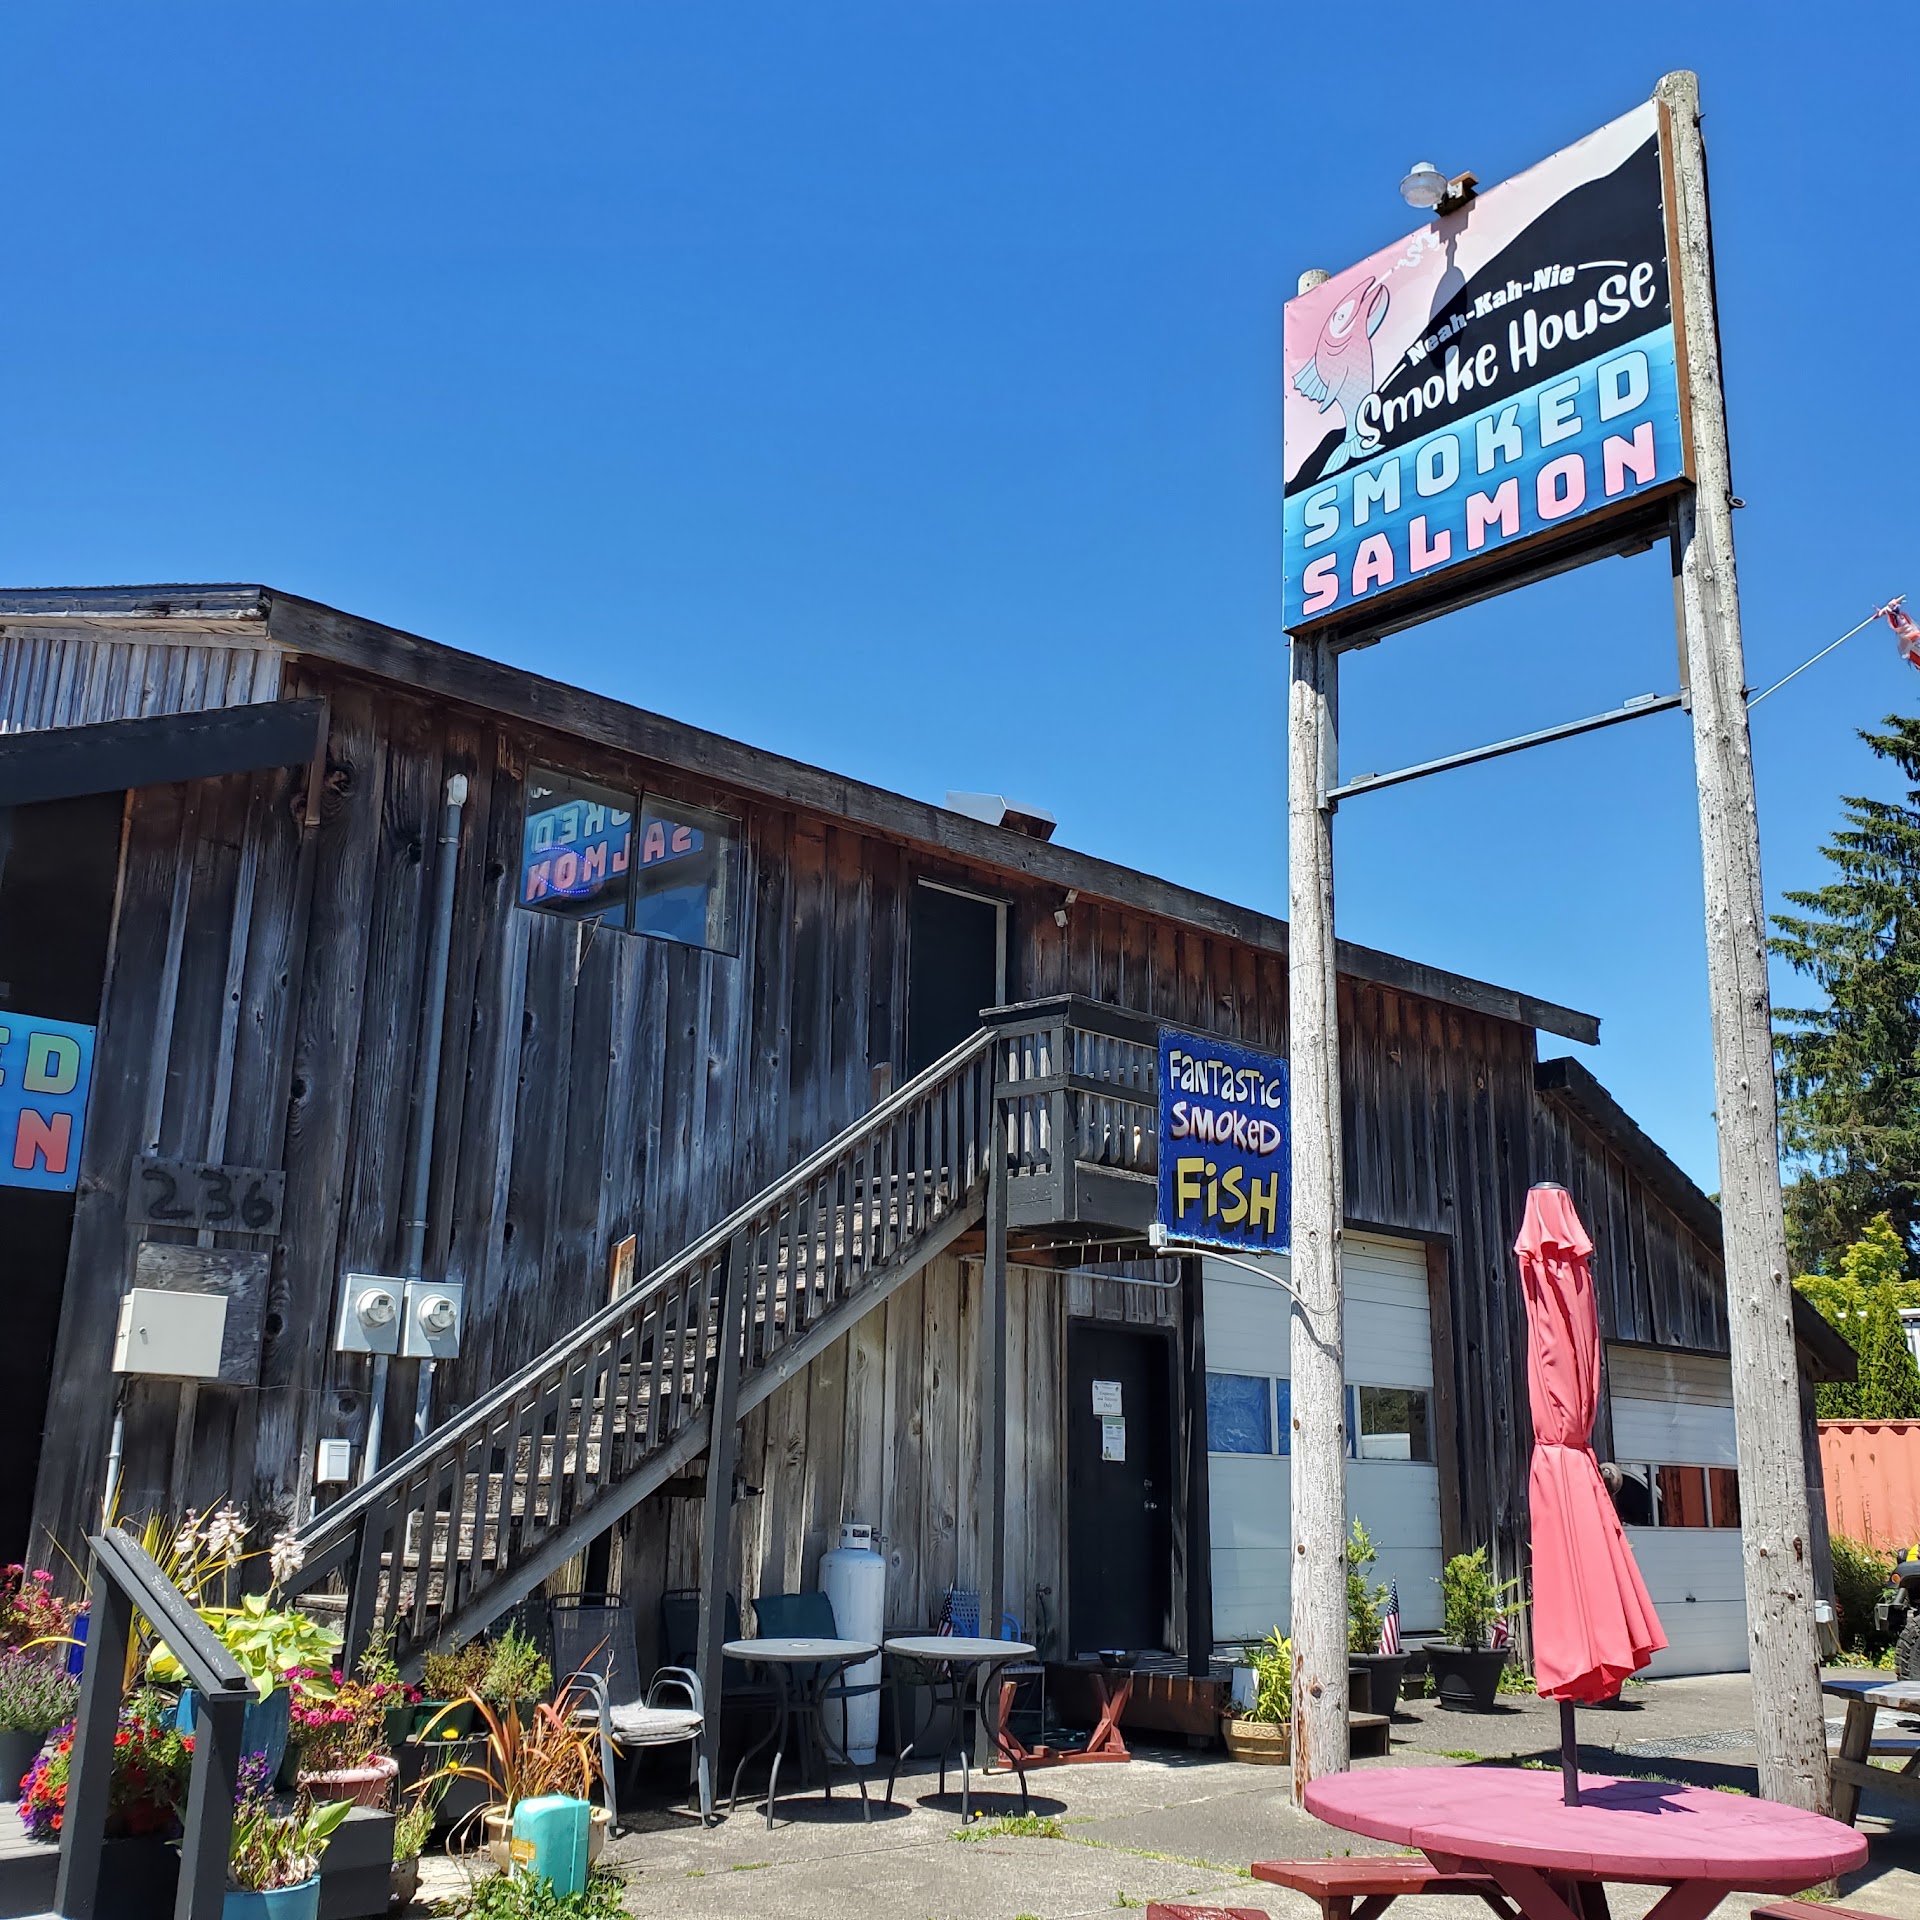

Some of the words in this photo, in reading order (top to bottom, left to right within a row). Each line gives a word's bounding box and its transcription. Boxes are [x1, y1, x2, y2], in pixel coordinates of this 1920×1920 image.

[1354, 341, 1499, 449] Smoke
[1508, 261, 1657, 371] House
[1405, 263, 1576, 366] Neah-Kah-Nie
[1301, 421, 1657, 617] SALMON
[1303, 349, 1651, 549] SMOKED
[142, 1168, 274, 1229] 236
